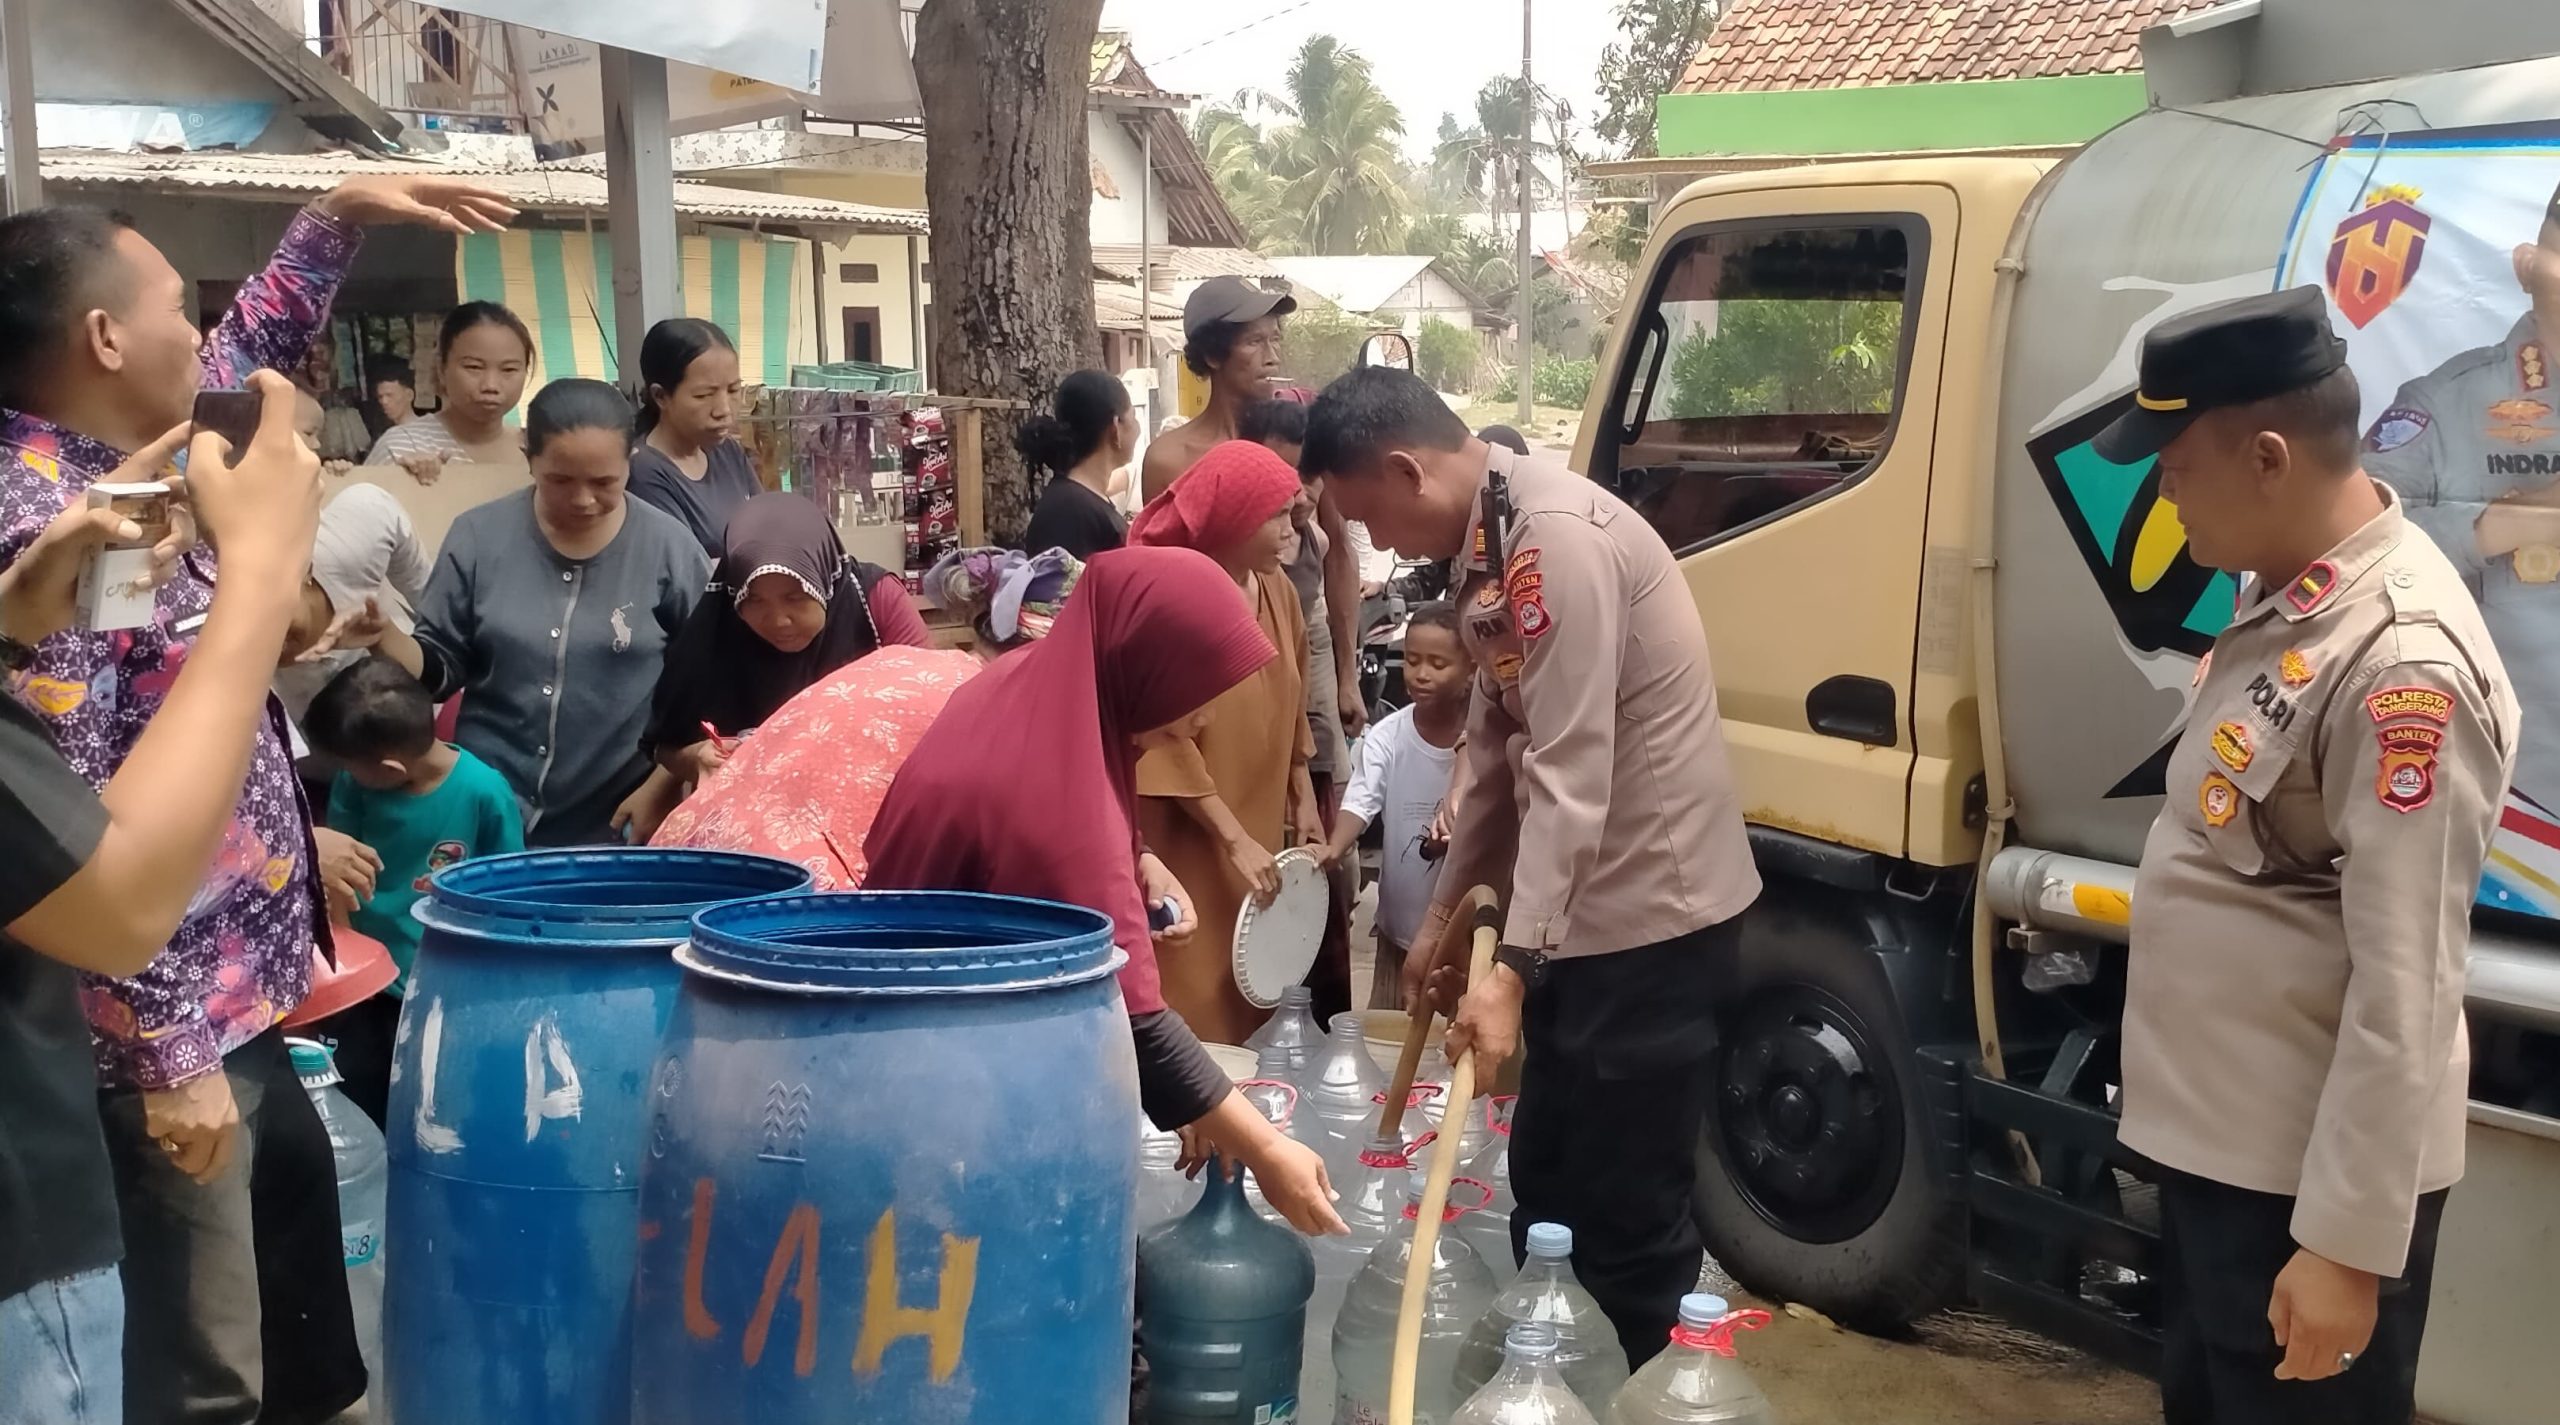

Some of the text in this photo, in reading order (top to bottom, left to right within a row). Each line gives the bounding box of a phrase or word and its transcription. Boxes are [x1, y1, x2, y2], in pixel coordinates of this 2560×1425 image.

[2244, 672, 2298, 732] POLRI
[2372, 691, 2449, 709] POLRESTA
[2375, 702, 2446, 718] TANGERANG
[2387, 729, 2436, 742] BANTEN
